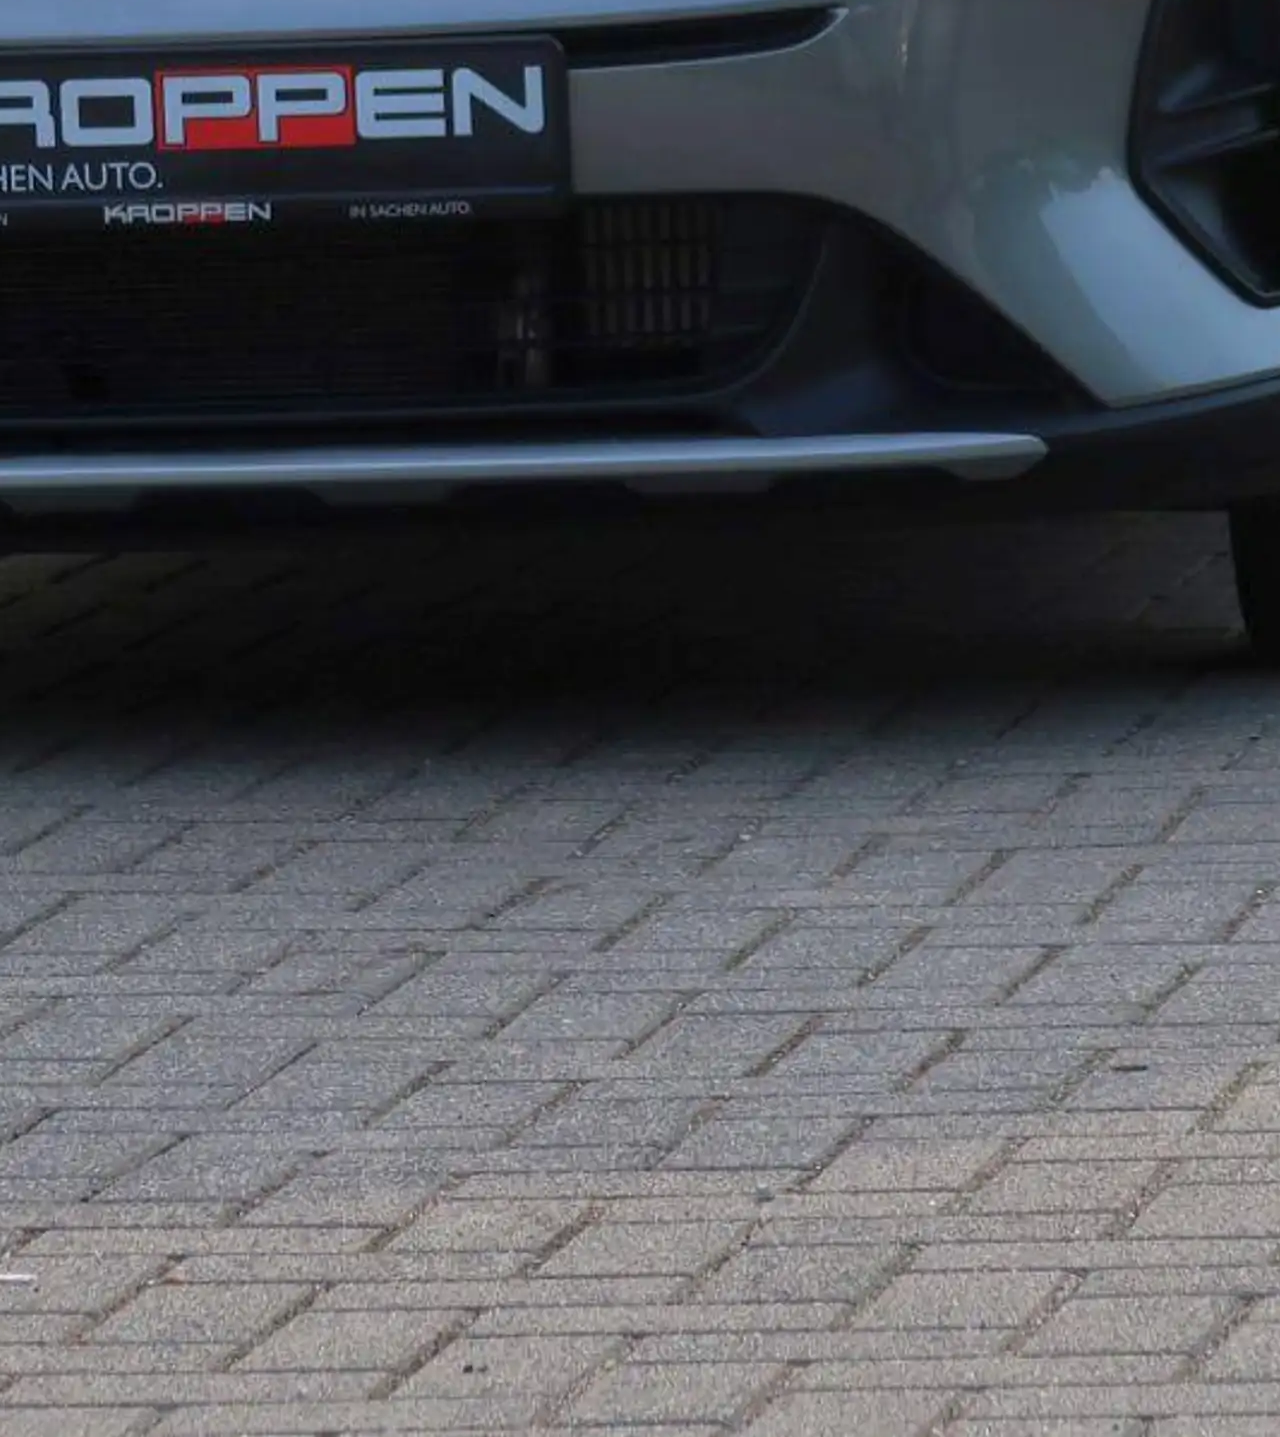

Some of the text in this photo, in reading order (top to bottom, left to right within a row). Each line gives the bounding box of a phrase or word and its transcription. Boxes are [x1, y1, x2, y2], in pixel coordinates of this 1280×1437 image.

[61, 161, 164, 192] AUTO.
[104, 202, 272, 225] KROPPEN
[349, 205, 367, 219] IN
[369, 202, 427, 218] SACHEN
